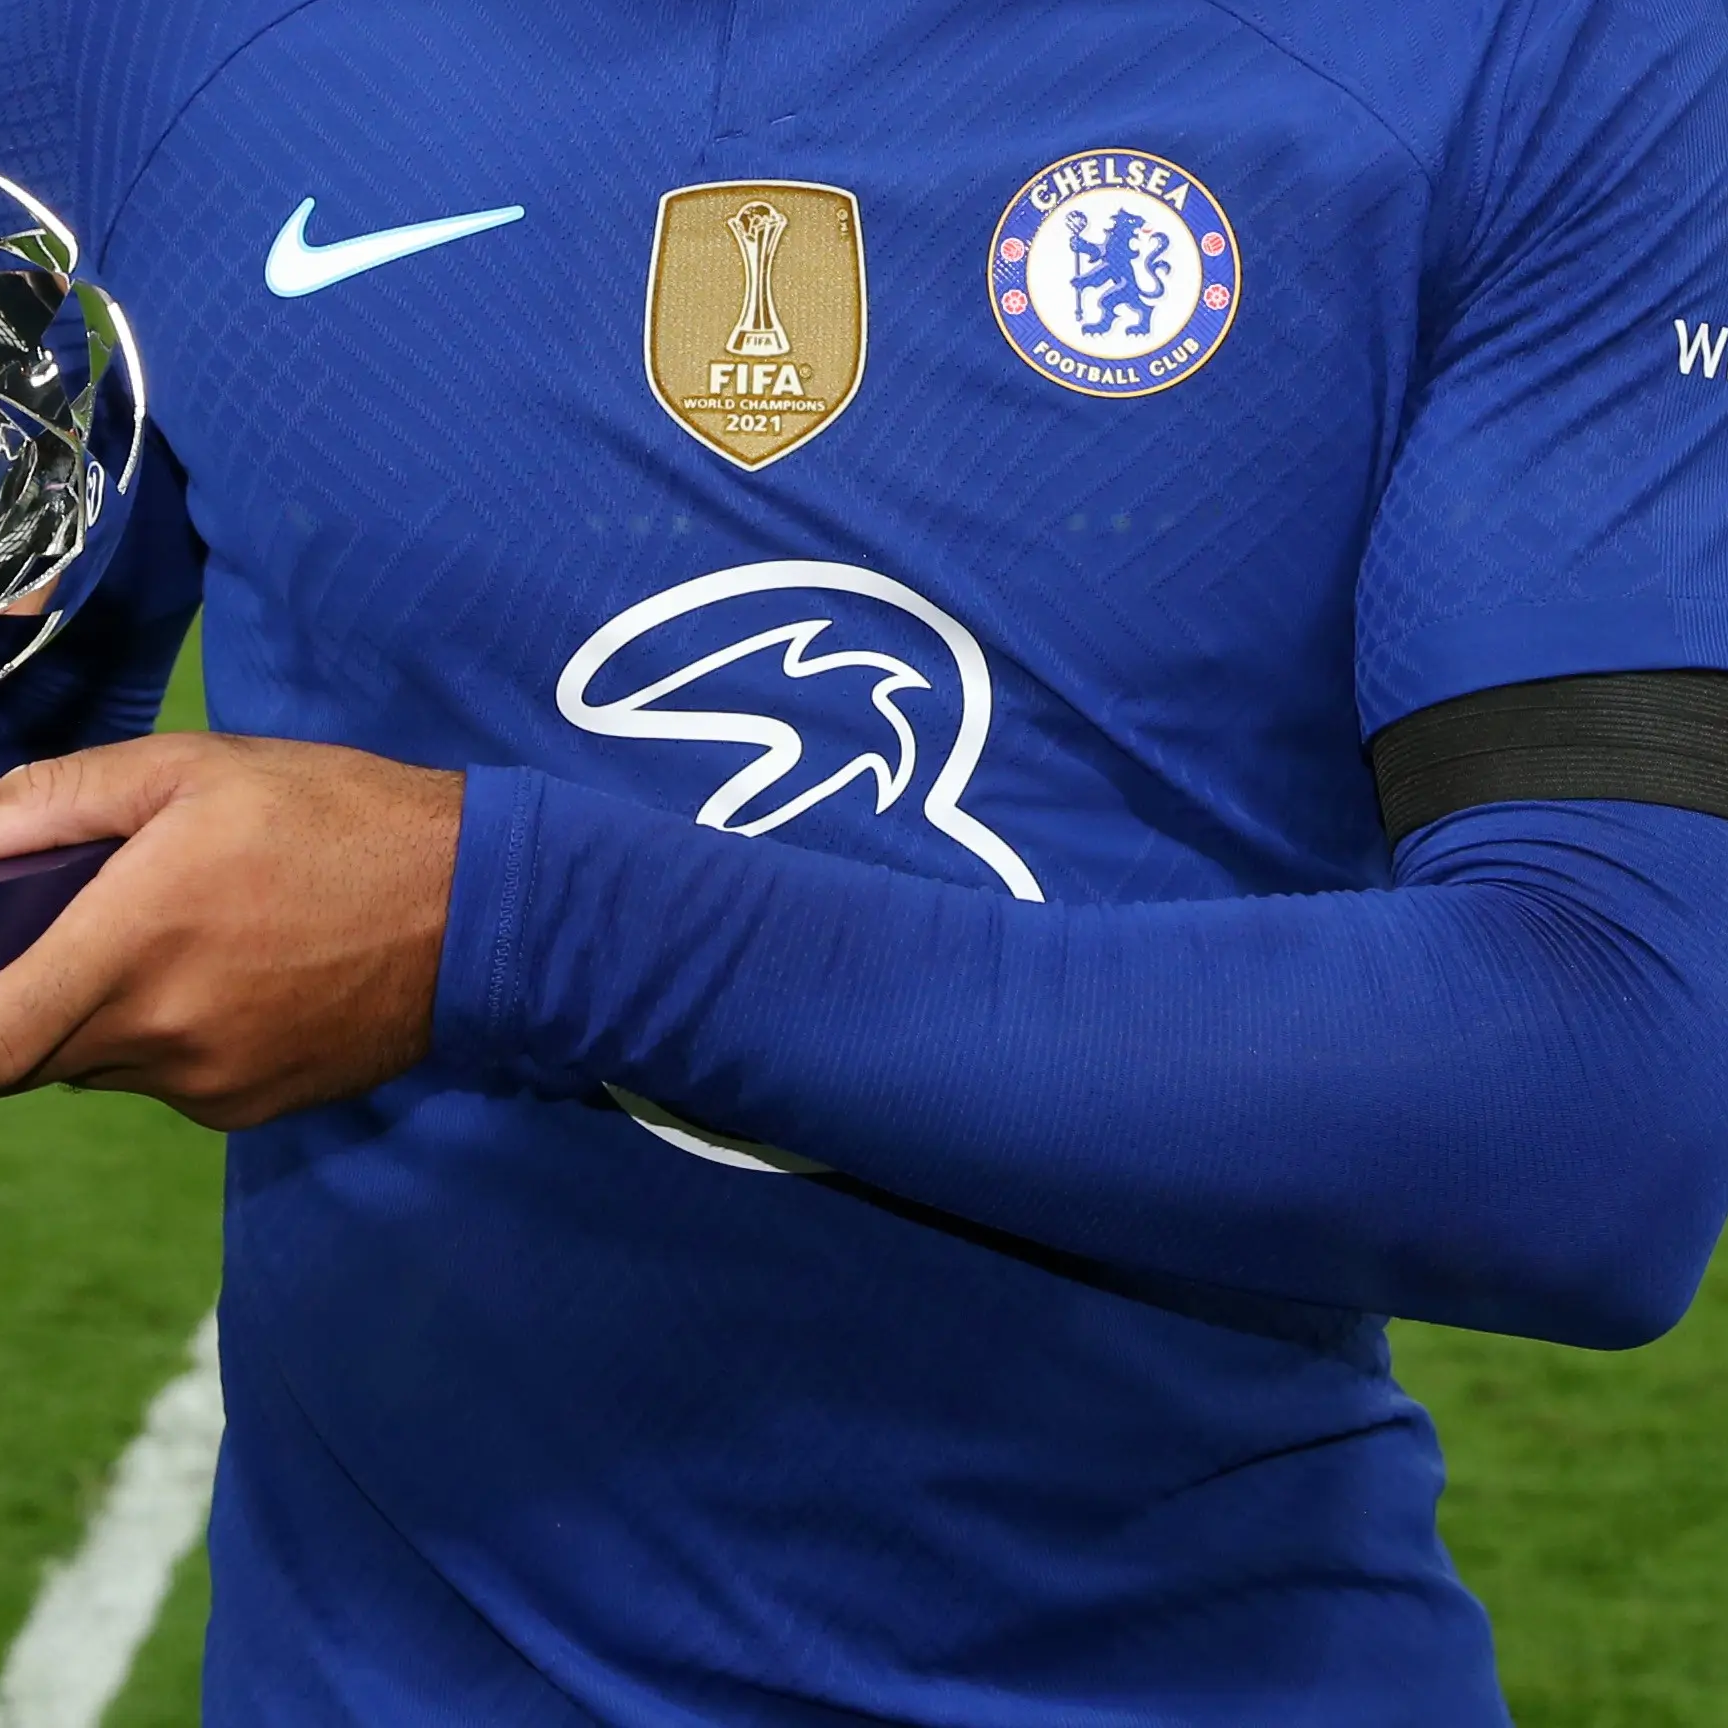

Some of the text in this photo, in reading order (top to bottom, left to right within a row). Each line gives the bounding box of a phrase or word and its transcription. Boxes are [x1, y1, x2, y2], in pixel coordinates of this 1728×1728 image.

[1029, 158, 1191, 211] CHELSEA
[745, 336, 773, 346] FIFA
[1032, 338, 1201, 385] FOOTBALL CLUB
[683, 397, 827, 412] WORLD CHAMPIONS
[725, 413, 783, 433] 2021
